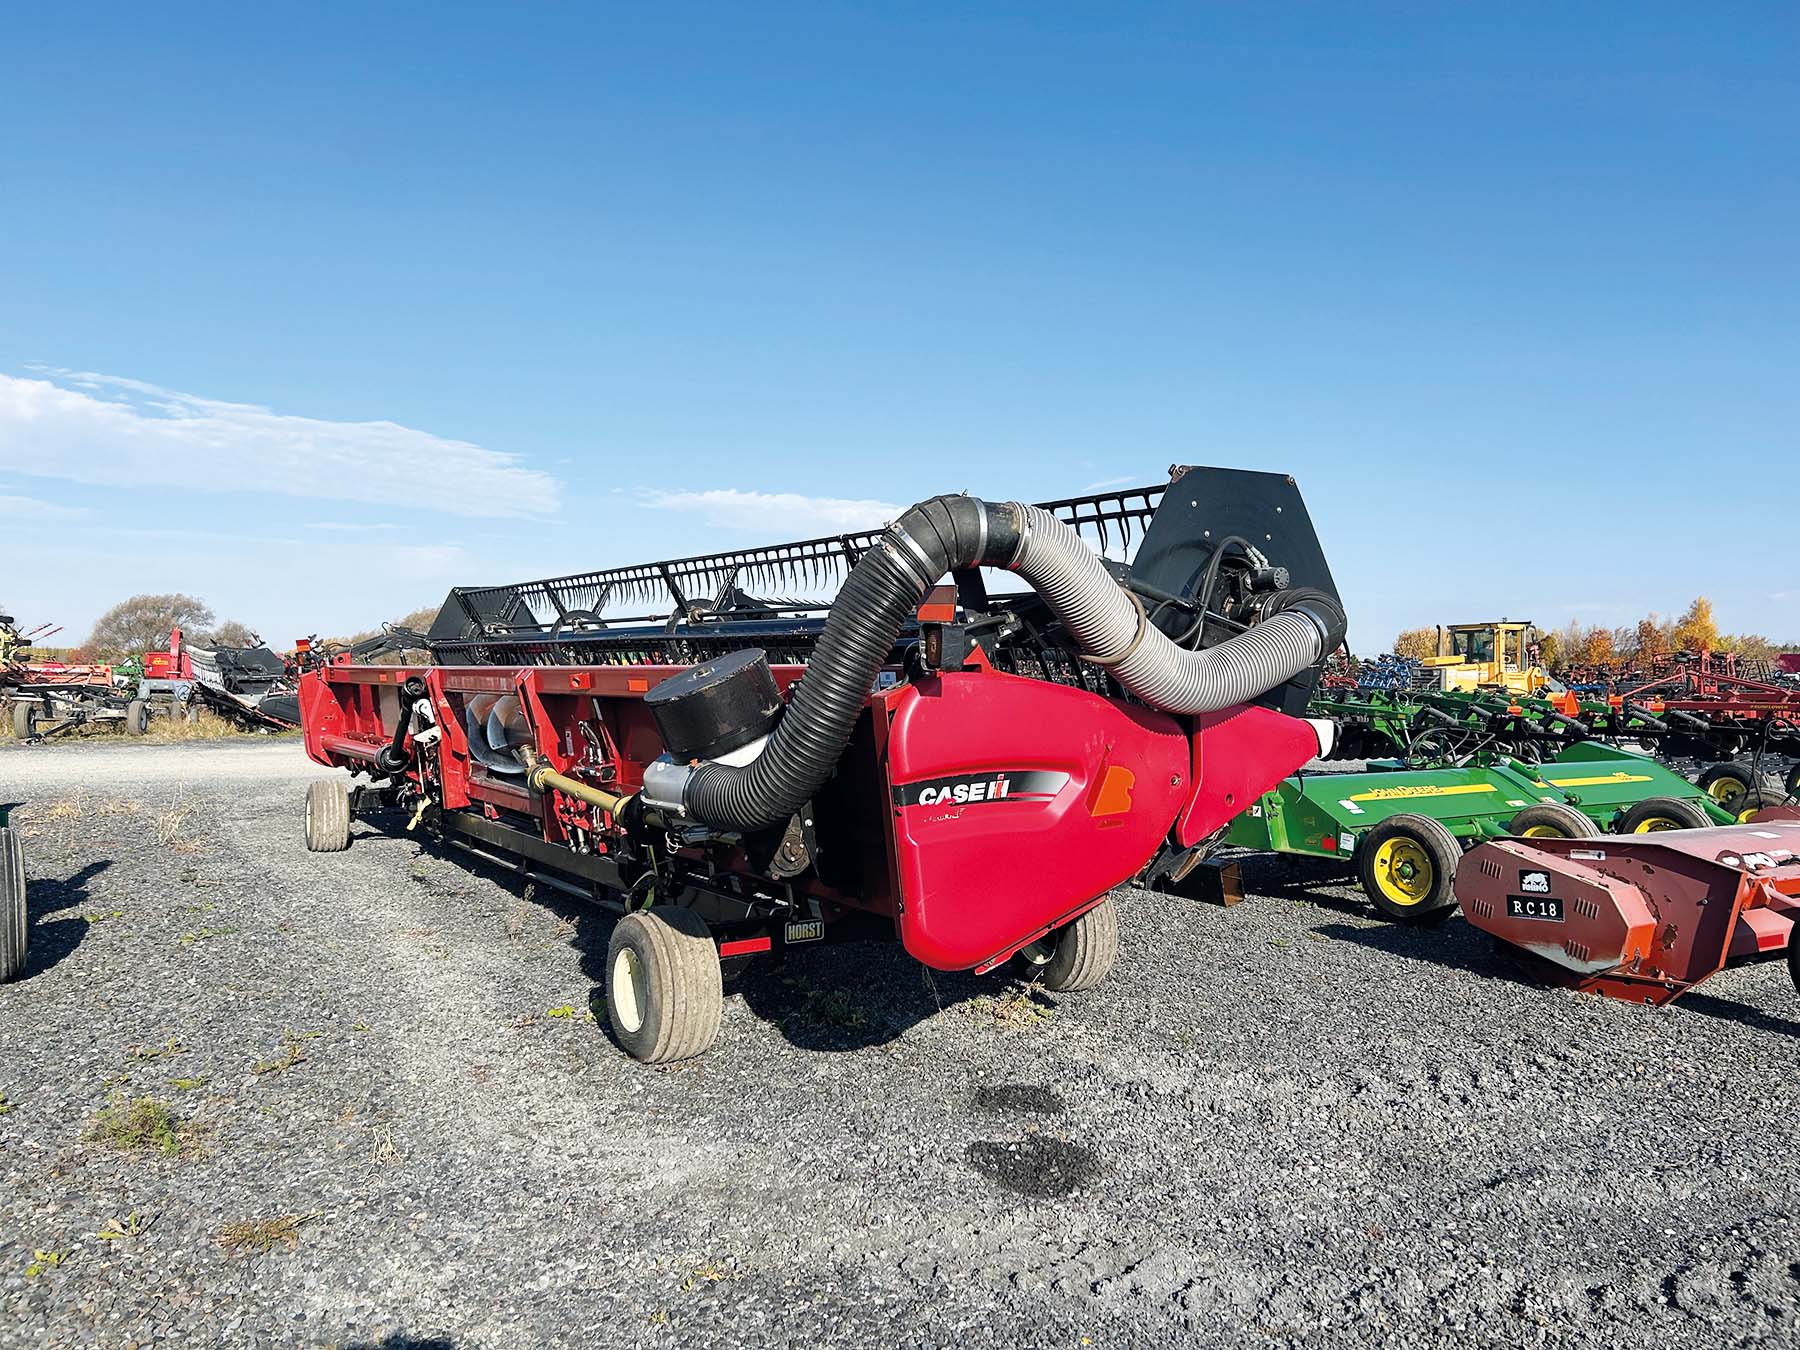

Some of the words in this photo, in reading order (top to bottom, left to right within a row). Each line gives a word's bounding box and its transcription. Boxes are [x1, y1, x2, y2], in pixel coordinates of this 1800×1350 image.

[919, 783, 987, 806] CASE
[1521, 883, 1549, 893] RHINO
[788, 921, 822, 940] HORST
